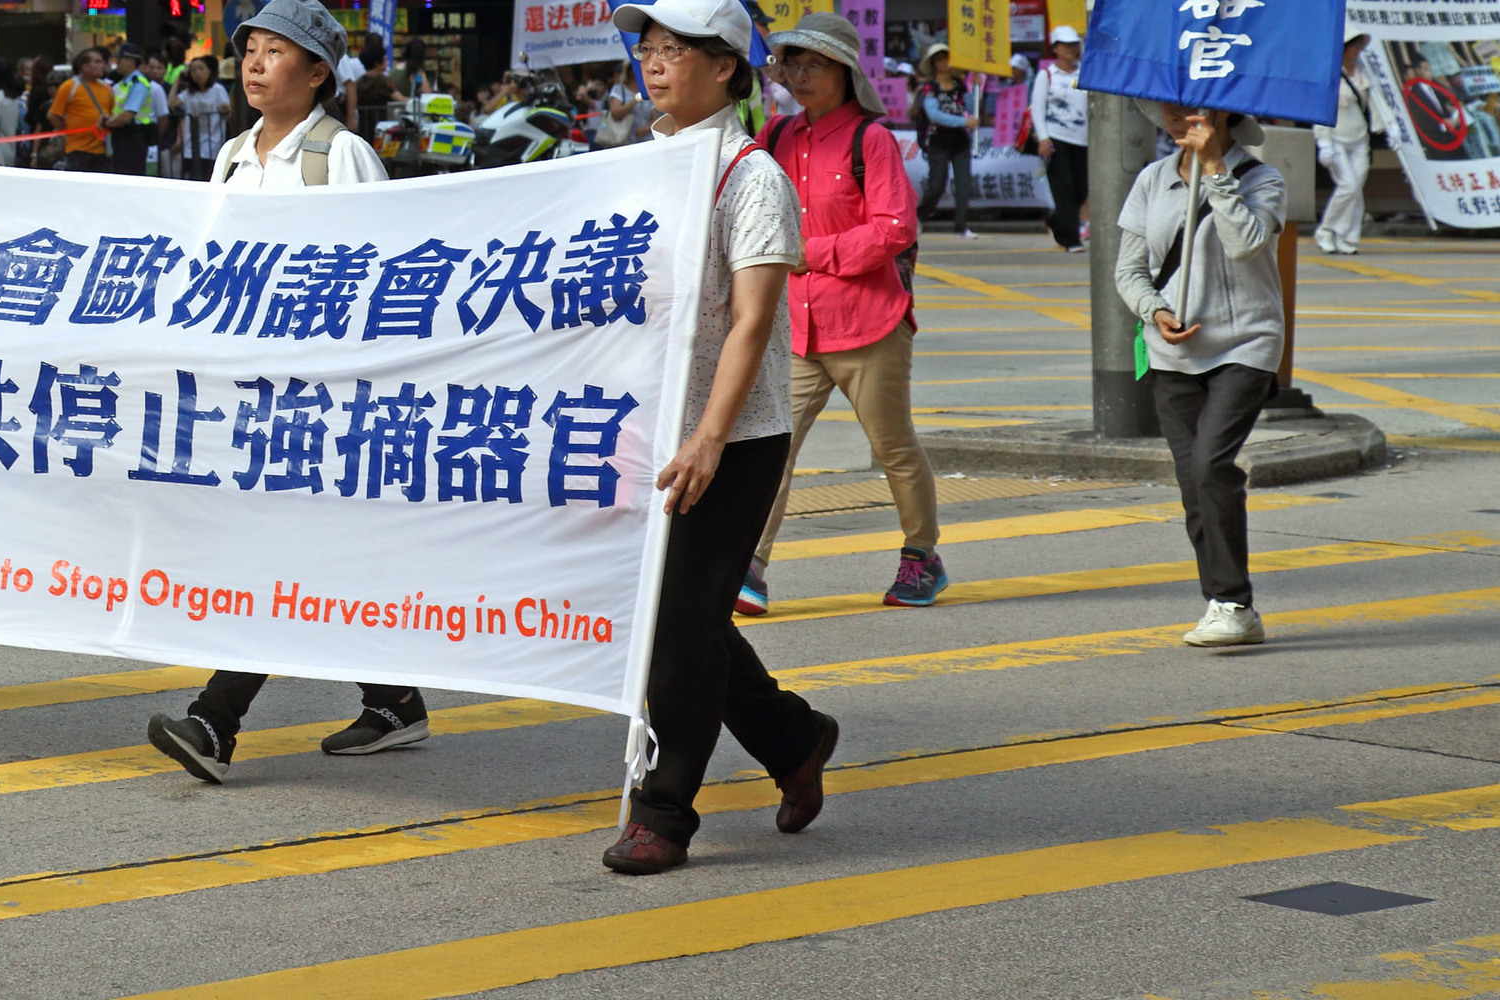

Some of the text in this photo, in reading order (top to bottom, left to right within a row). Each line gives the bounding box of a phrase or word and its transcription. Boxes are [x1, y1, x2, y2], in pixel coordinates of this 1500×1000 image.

[525, 39, 564, 52] Eliminate
[566, 35, 609, 47] Chinese
[0, 558, 34, 593] to
[48, 560, 129, 612] Stop
[140, 569, 254, 621] Organ
[272, 580, 466, 642] Harvesting
[476, 595, 507, 635] in
[515, 597, 613, 644] China
